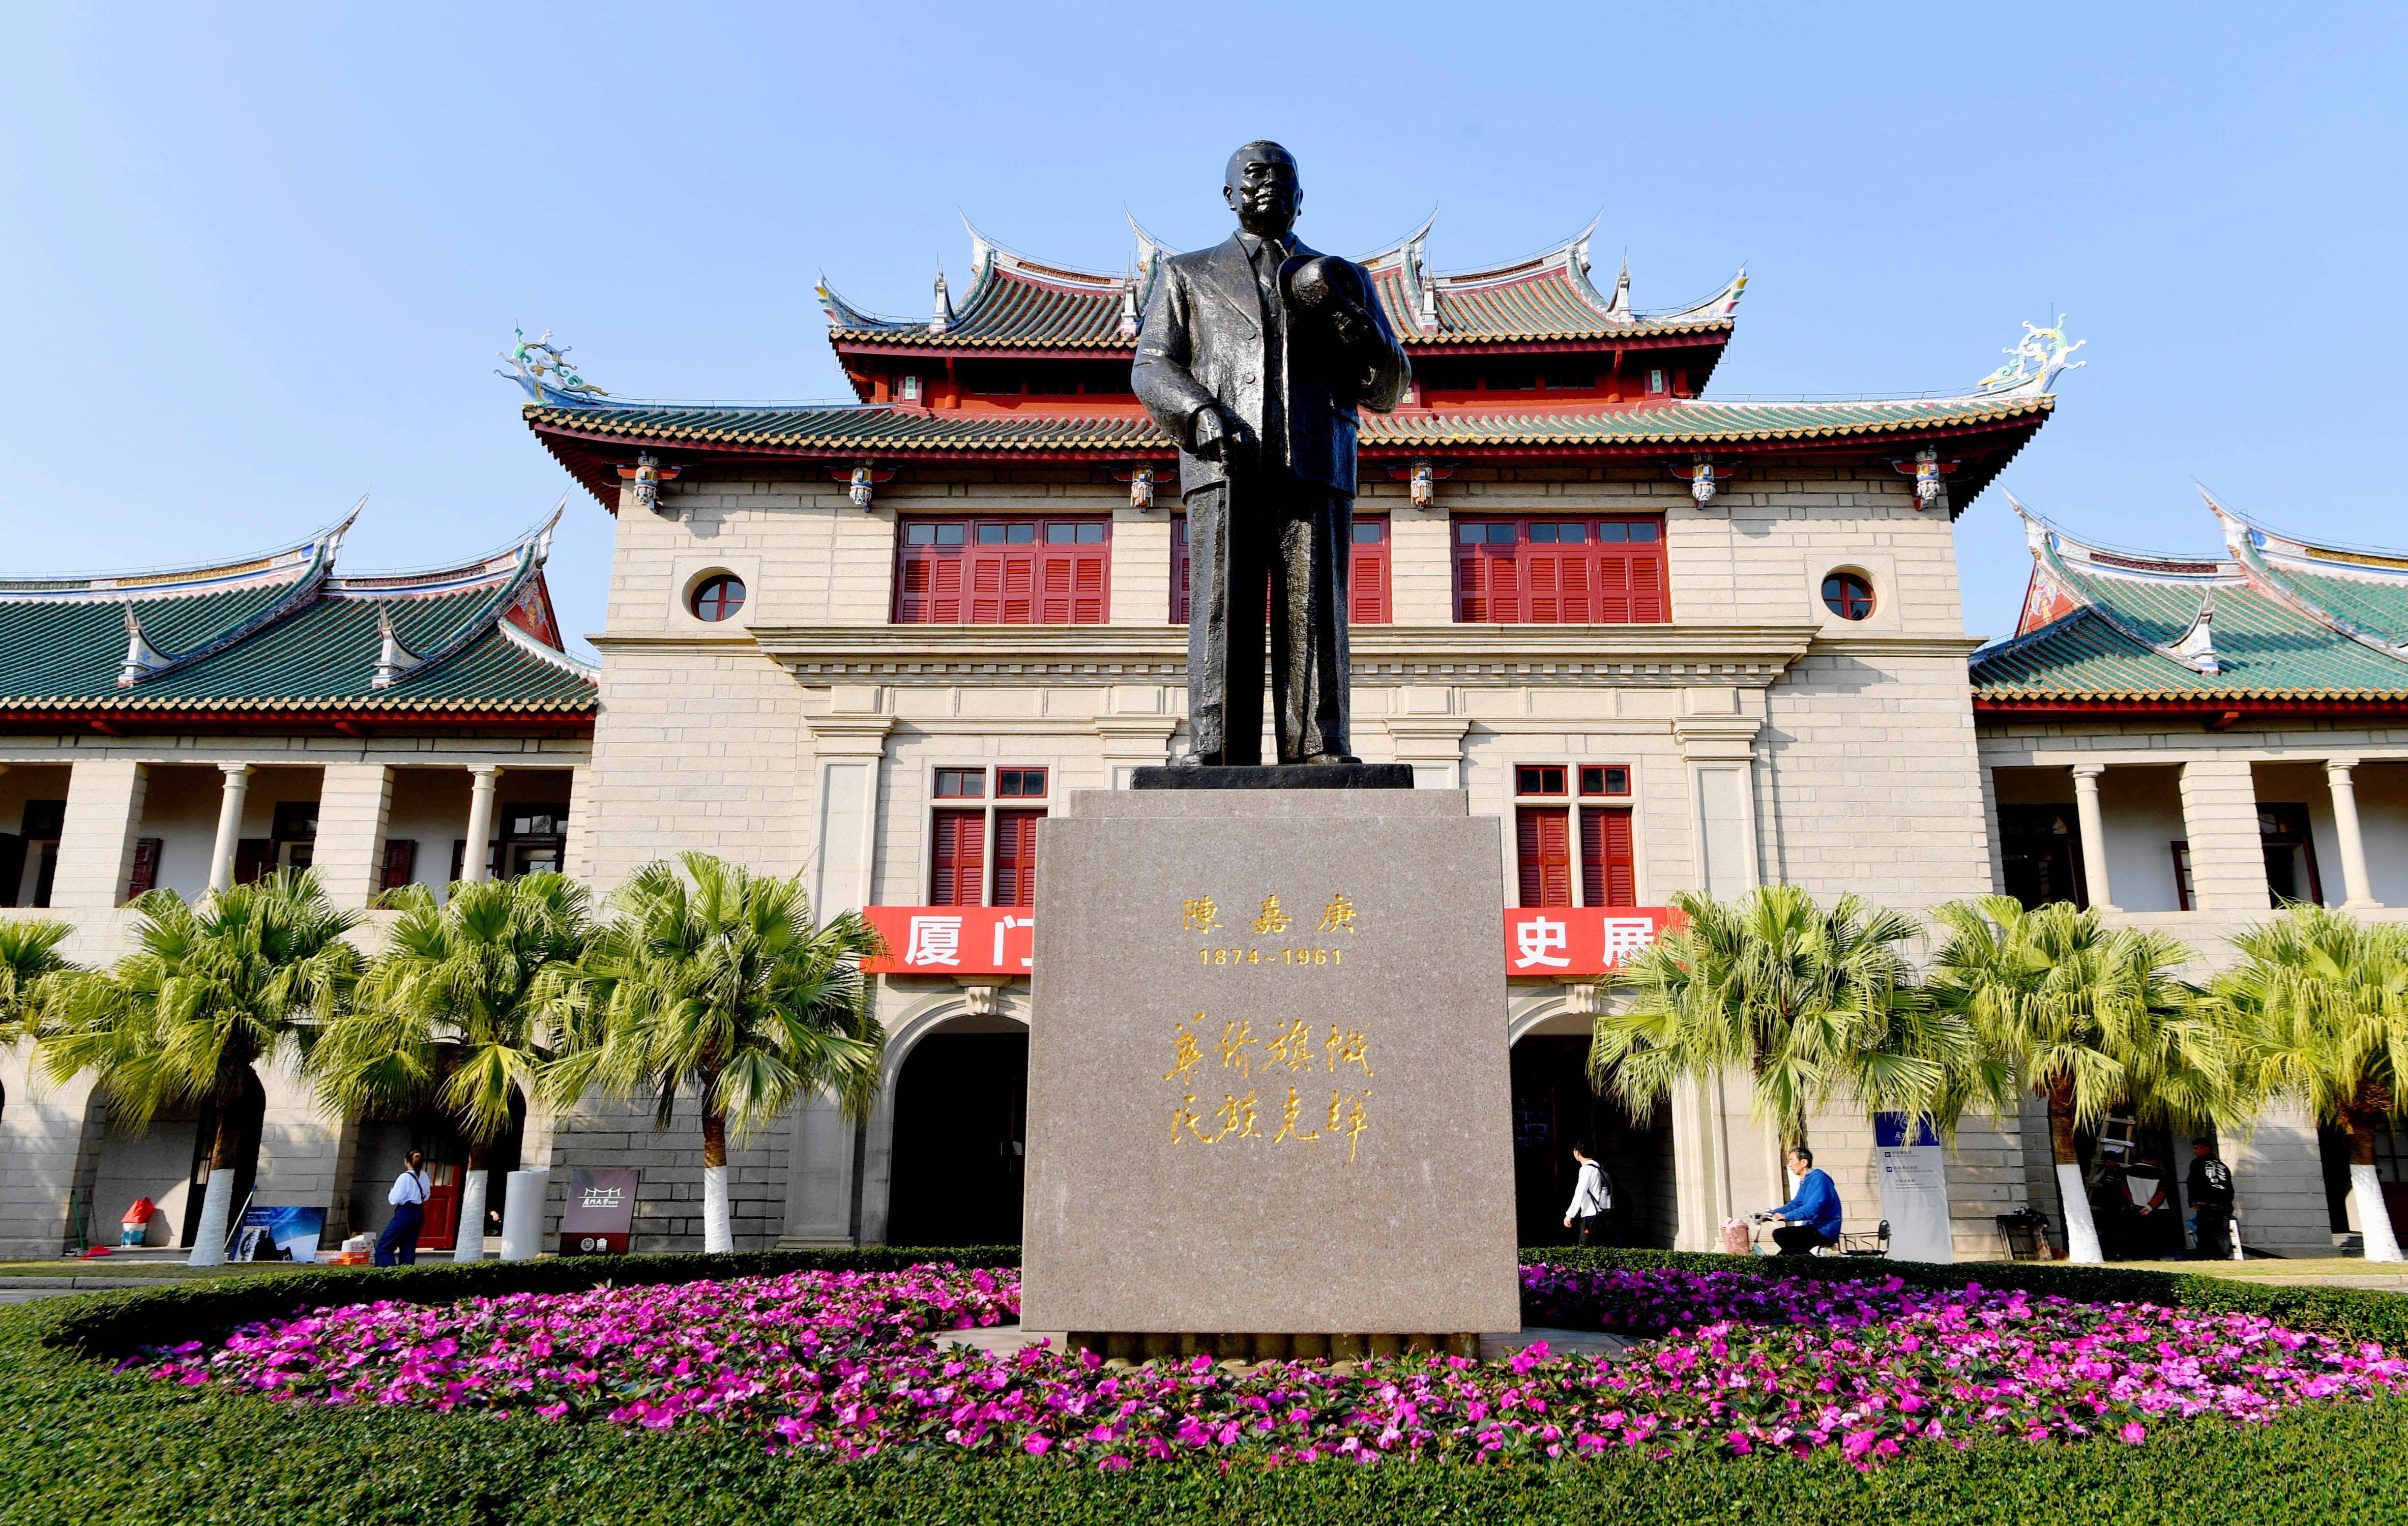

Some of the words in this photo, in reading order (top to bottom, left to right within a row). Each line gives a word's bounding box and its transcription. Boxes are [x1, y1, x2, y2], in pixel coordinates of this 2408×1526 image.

[1183, 893, 1357, 935] 陳嘉庚
[905, 916, 1033, 966] 厦门
